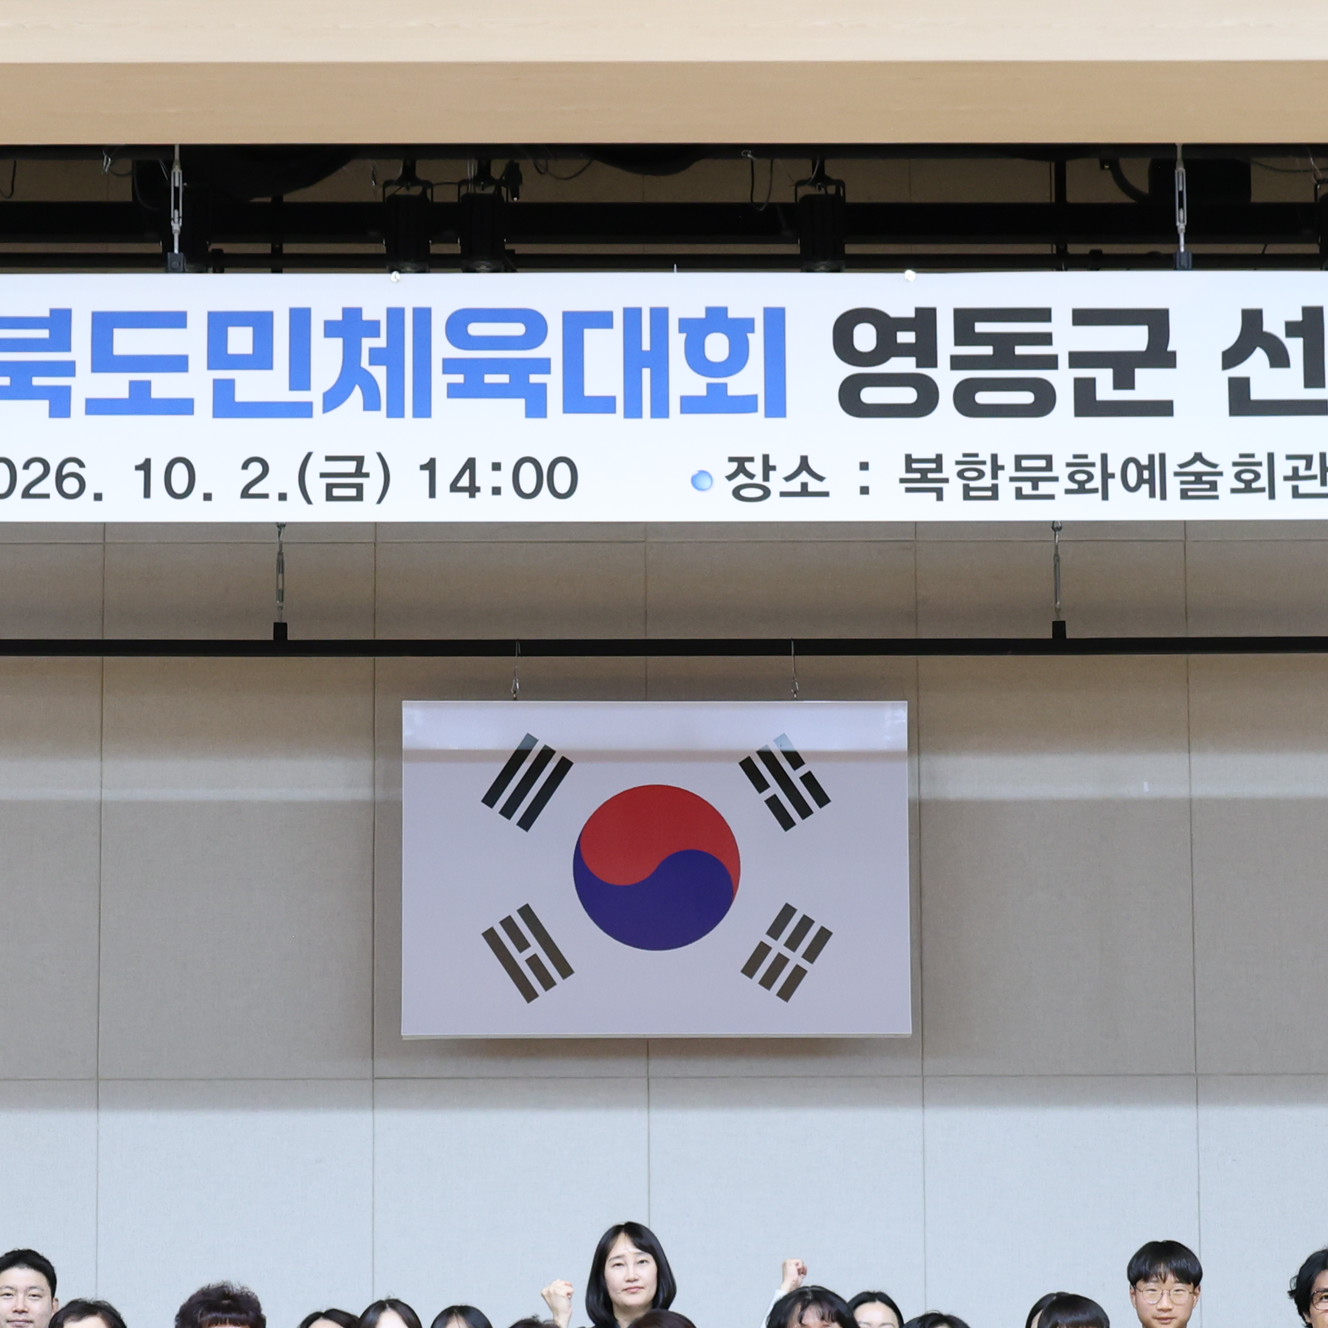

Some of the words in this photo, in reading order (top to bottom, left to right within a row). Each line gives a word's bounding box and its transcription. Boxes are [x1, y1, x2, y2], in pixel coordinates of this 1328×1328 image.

[832, 306, 1177, 419] 영동군
[134, 456, 213, 502] 10.
[239, 451, 391, 505] 2.(금)
[419, 456, 579, 500] 14:00
[724, 453, 830, 503] 장소
